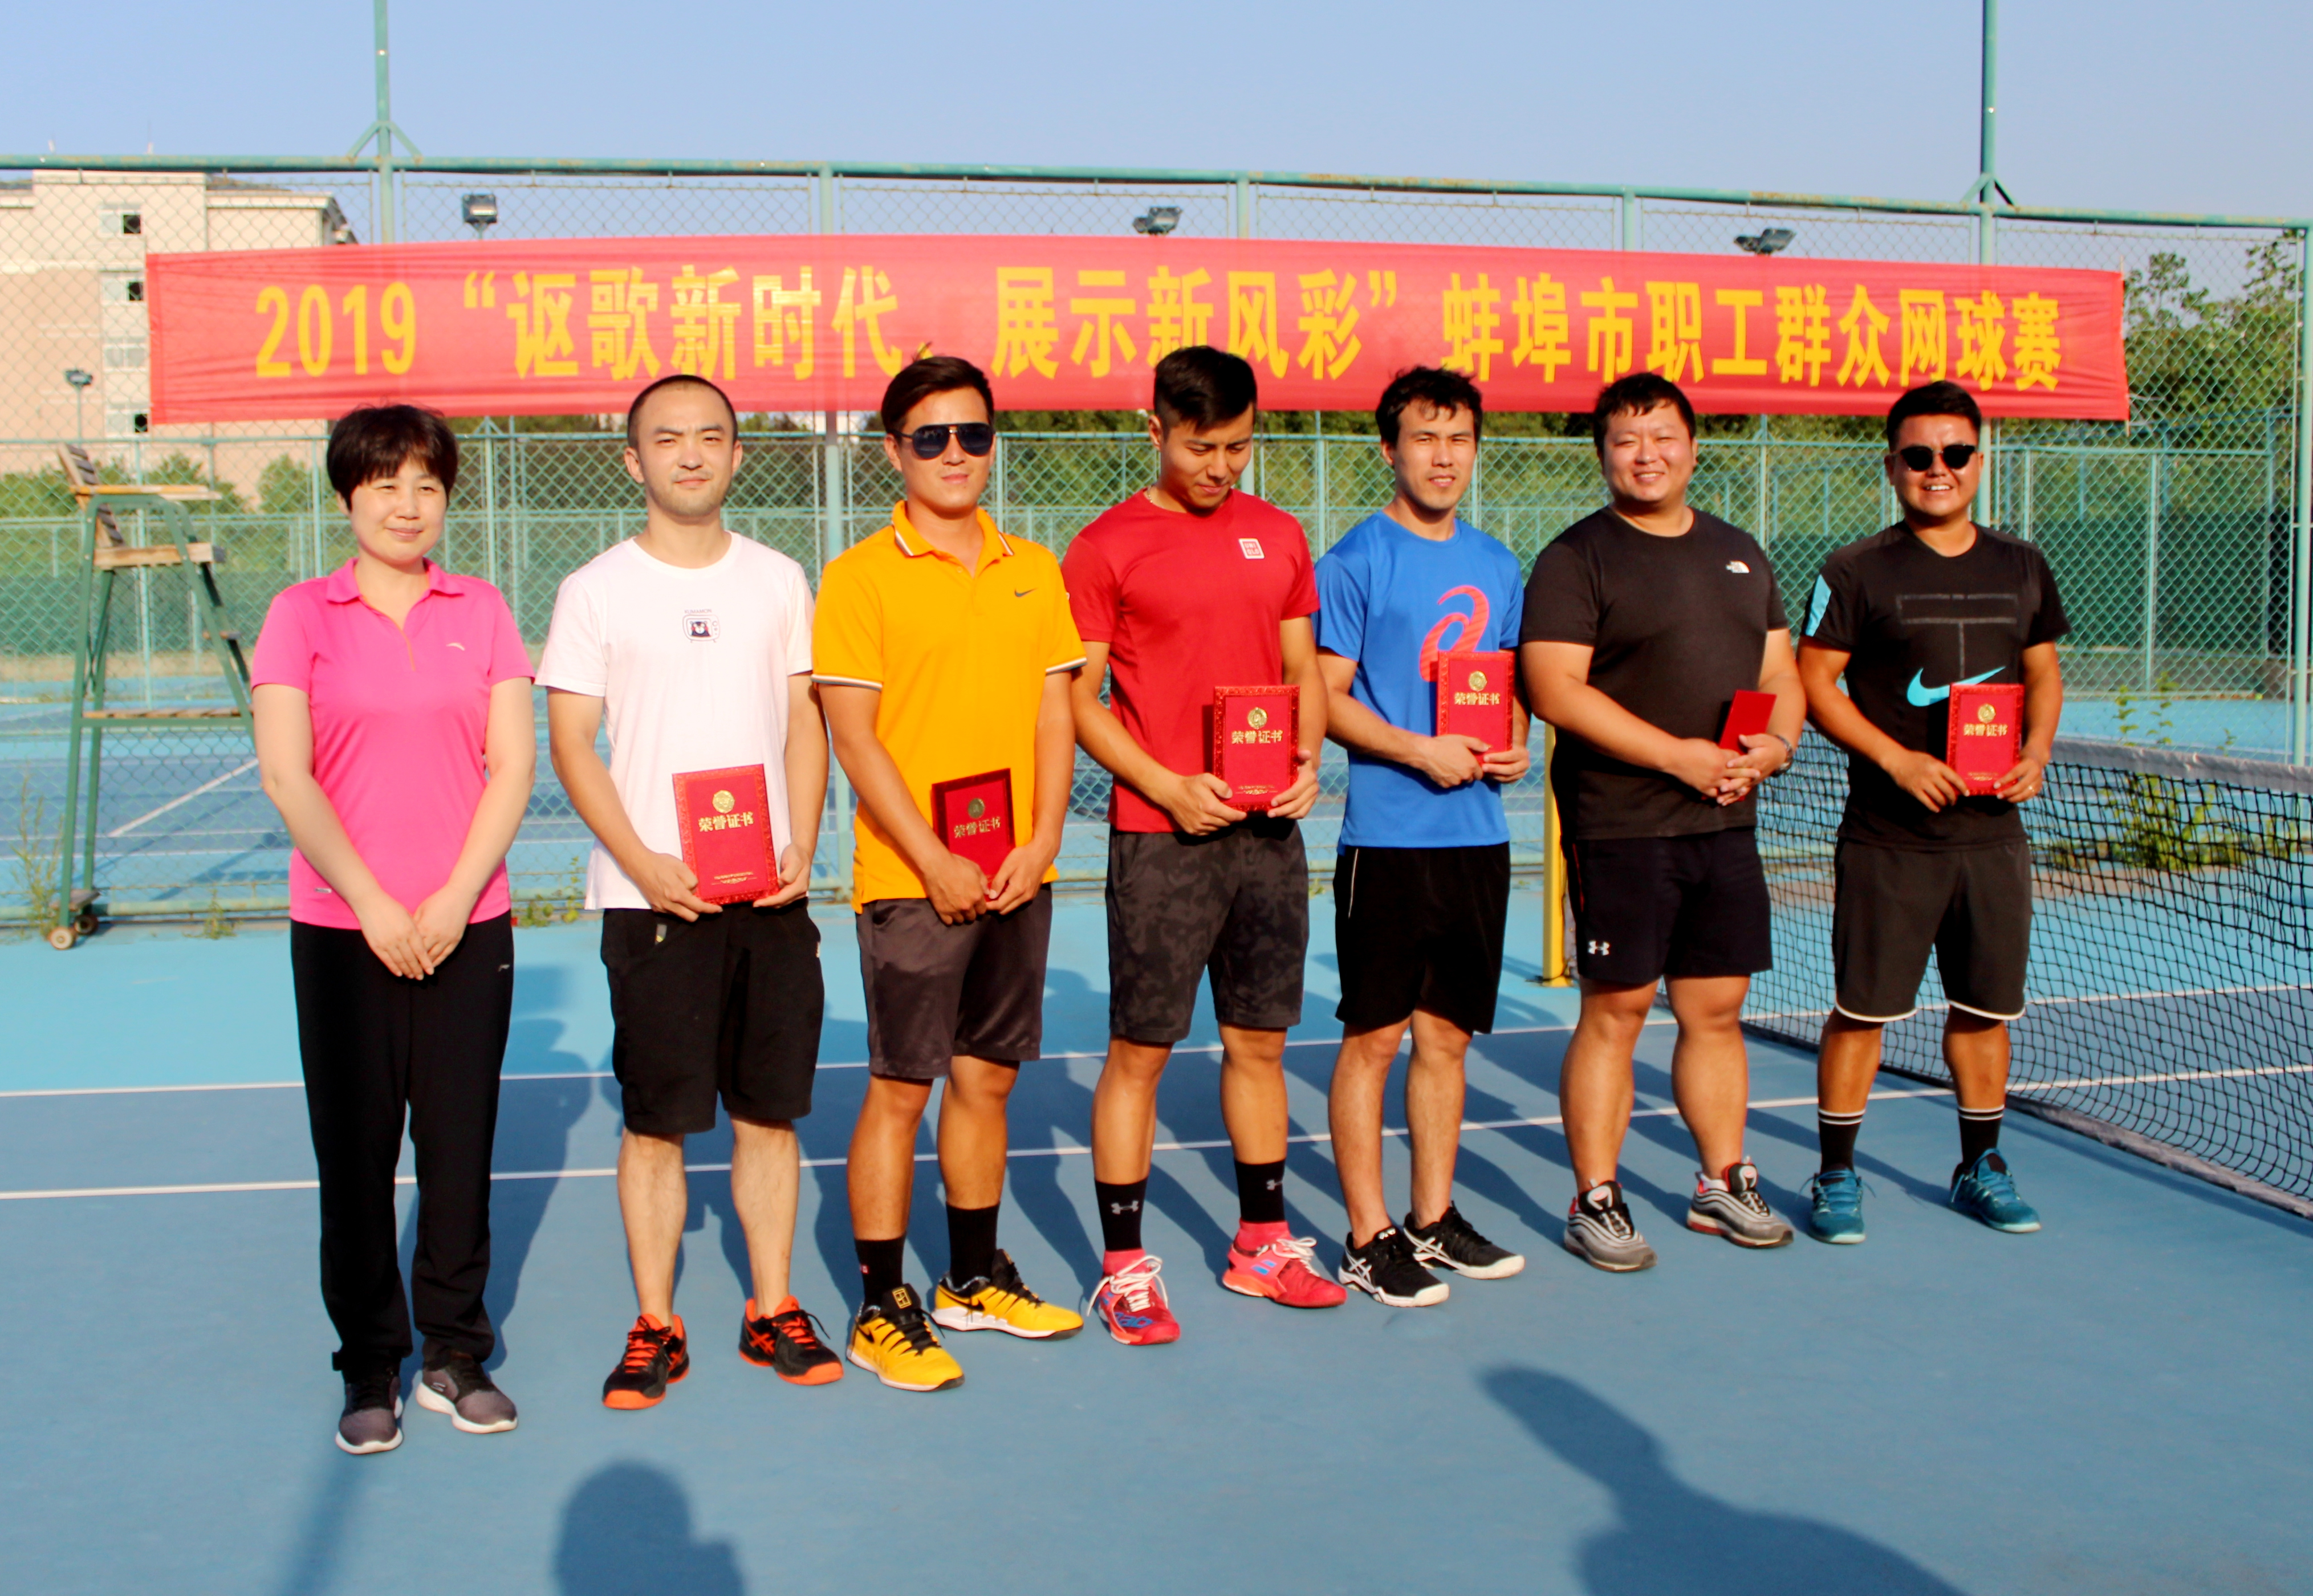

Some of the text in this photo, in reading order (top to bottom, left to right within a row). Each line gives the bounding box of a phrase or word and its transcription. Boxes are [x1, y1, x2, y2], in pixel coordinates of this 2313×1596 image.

[255, 281, 417, 377] 2019
[1441, 272, 2062, 392] 蚌埠市职工群众网球赛
[1454, 692, 1501, 706] 荣誉证书
[1231, 730, 1283, 744] 荣誉证书
[1963, 722, 2008, 736] 荣誉证书
[698, 811, 754, 832] 荣誉证书
[954, 816, 1001, 838] 荣誉证书
